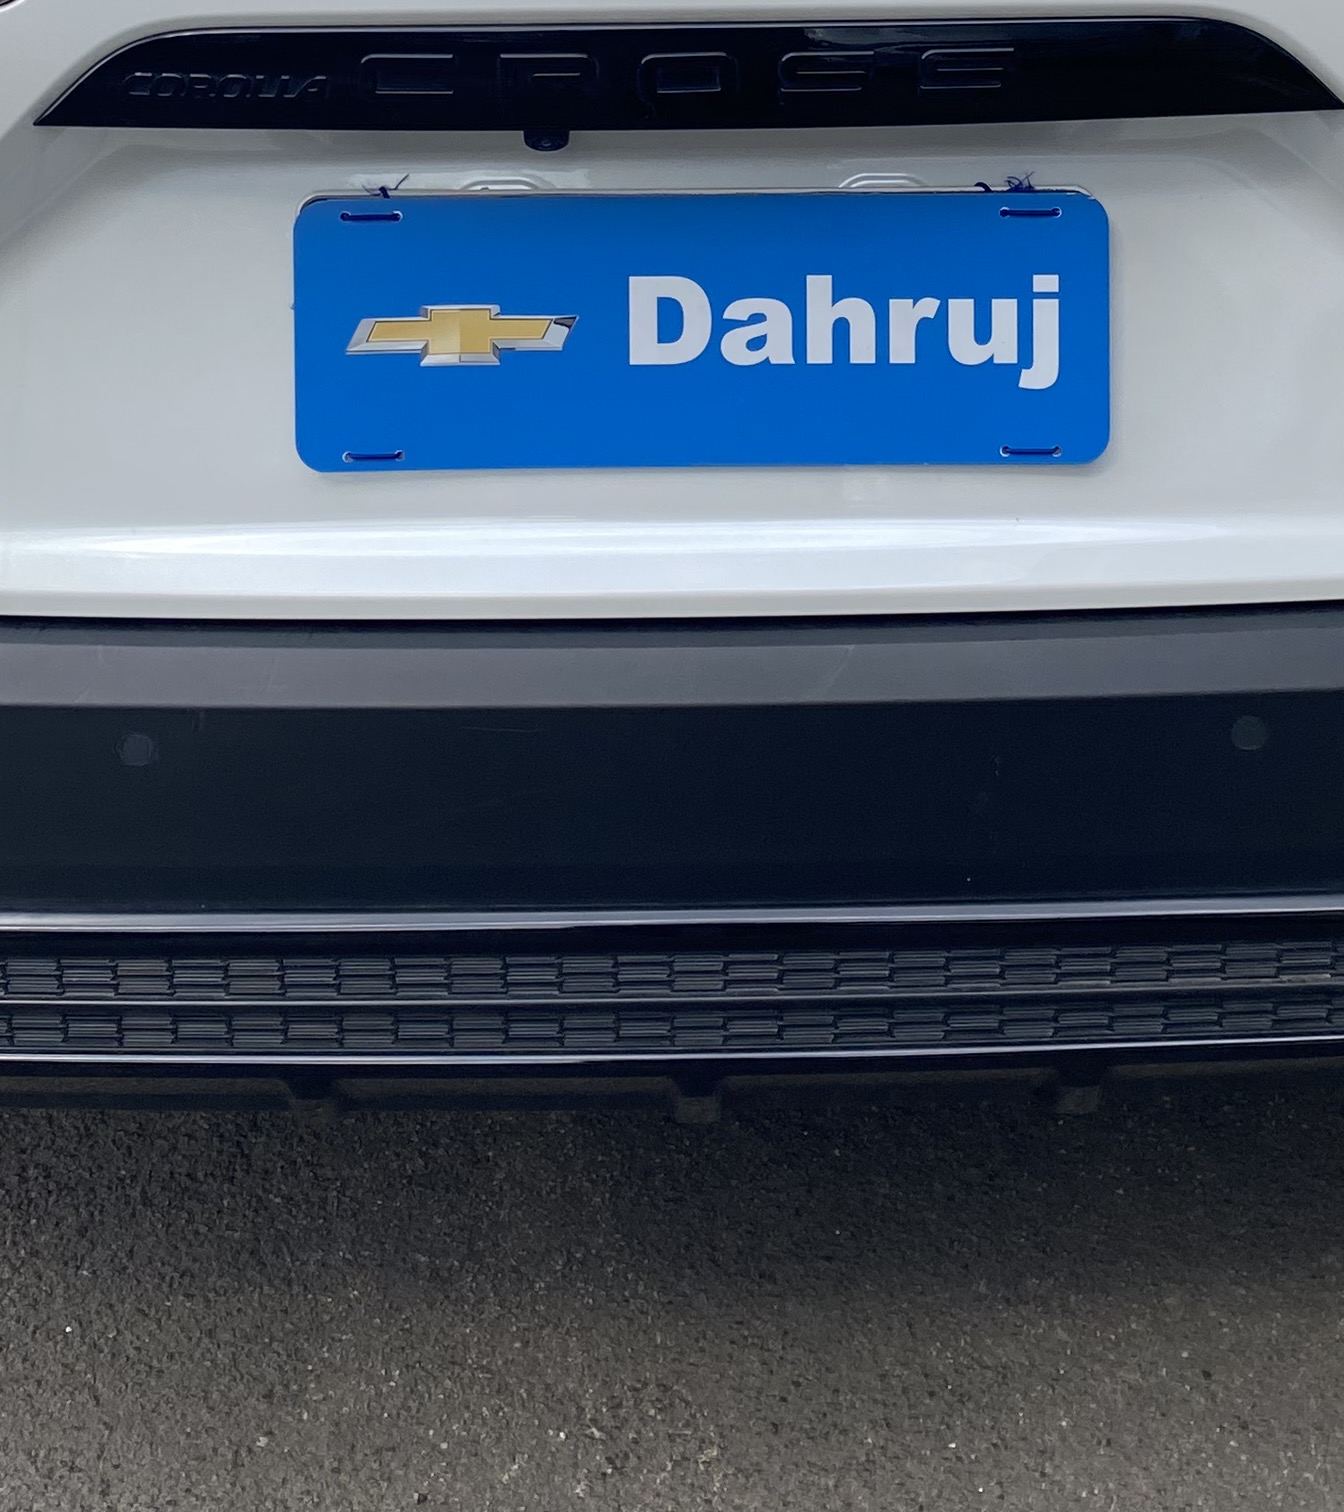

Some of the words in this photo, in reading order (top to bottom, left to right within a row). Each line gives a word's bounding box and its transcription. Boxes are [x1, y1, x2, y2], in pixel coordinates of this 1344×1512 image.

[123, 71, 329, 99] COROLLA
[359, 45, 1016, 100] CROSS
[628, 274, 1061, 390] Dahruj
